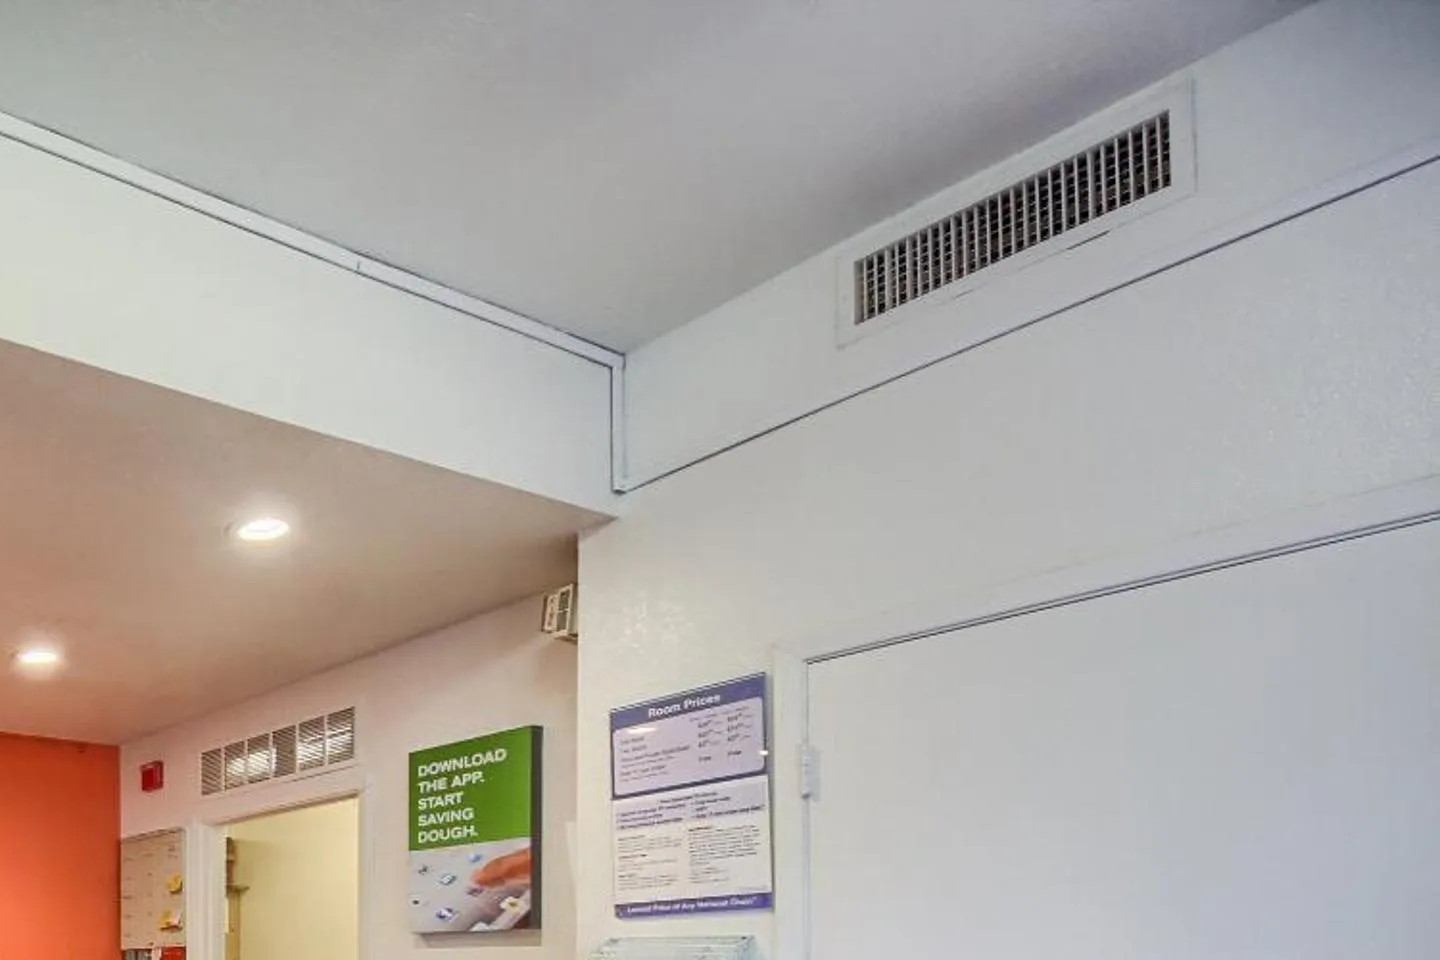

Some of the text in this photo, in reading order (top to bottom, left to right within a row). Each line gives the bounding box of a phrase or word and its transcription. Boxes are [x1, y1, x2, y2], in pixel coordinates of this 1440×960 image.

[648, 703, 681, 719] Room
[417, 748, 508, 777] DOWNLOAD
[417, 771, 485, 793] THE APP.
[417, 791, 464, 810] START
[418, 807, 475, 827] SAVING
[417, 825, 479, 843] DOUGH.
